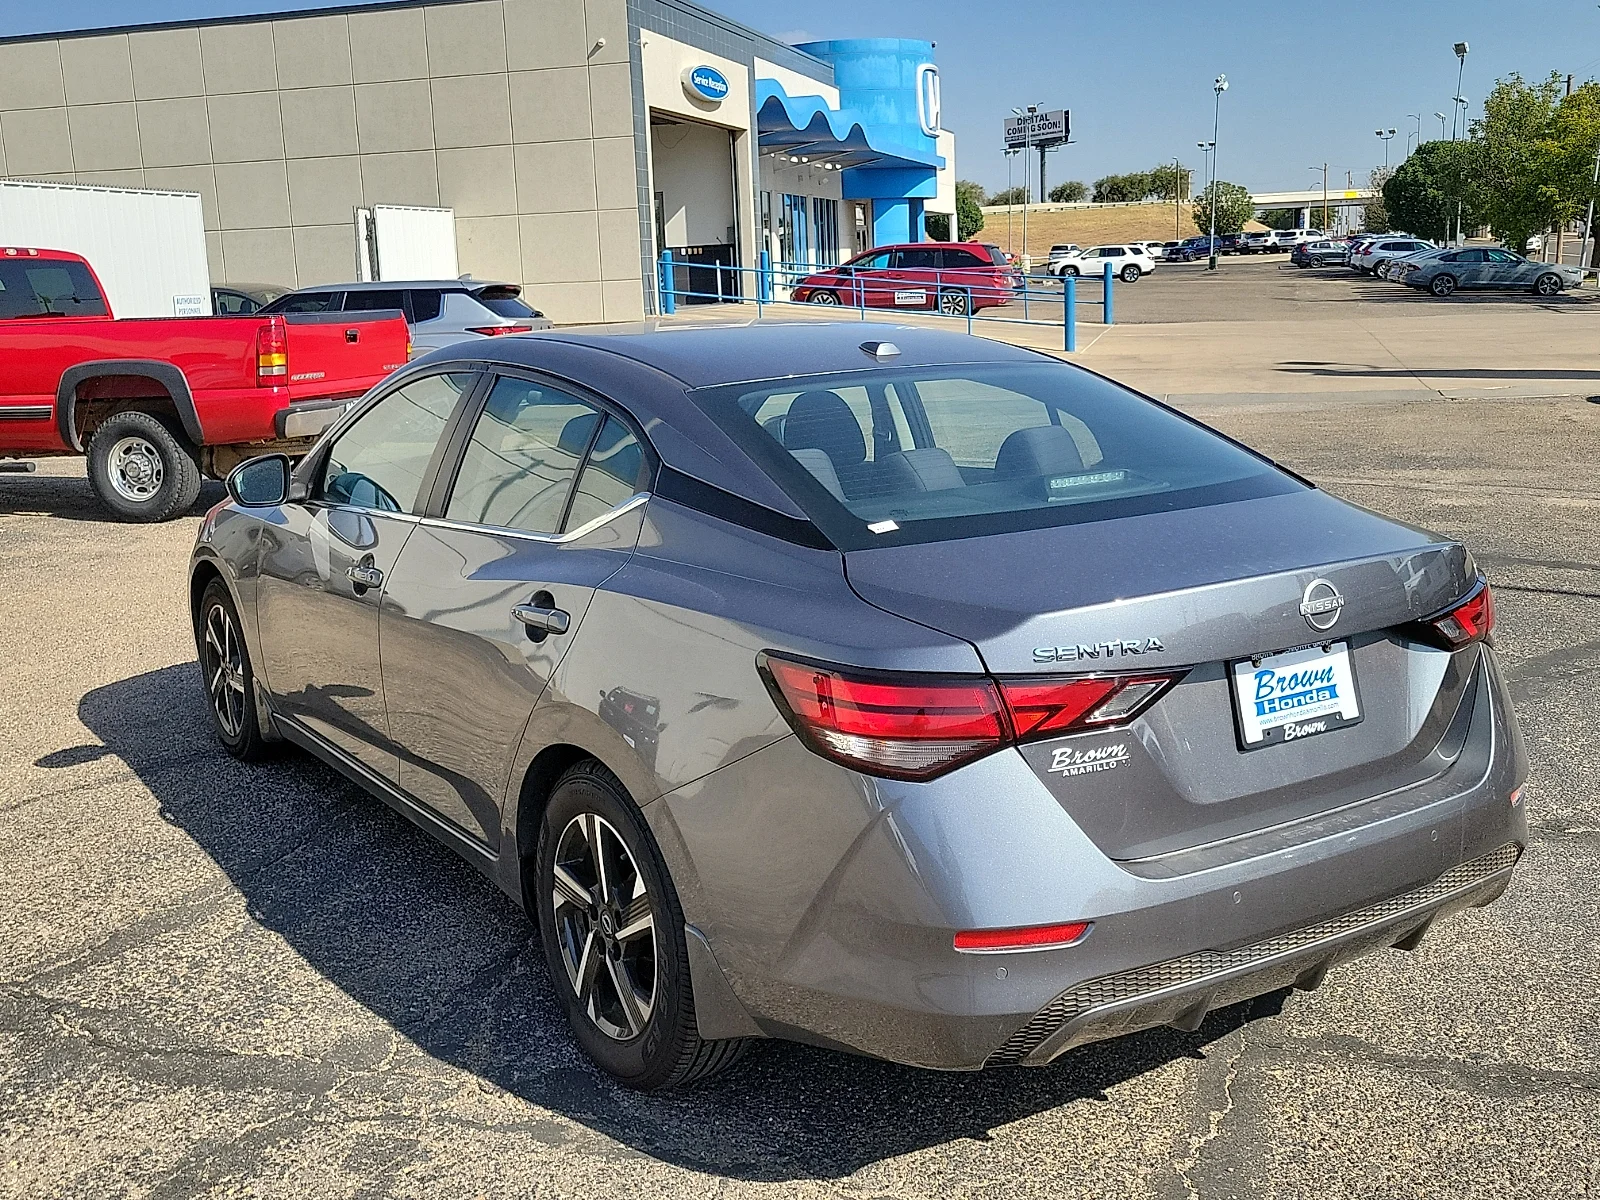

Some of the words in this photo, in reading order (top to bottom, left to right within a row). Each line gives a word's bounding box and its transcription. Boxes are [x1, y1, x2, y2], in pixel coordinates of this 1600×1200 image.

[1007, 125, 1036, 136] COMIG
[1037, 121, 1061, 131] SOON!
[1300, 595, 1345, 615] NISSAN
[1033, 637, 1165, 663] SENTRA
[1254, 666, 1334, 700] Brown
[1263, 688, 1331, 714] Honda
[1283, 721, 1327, 741] Brown
[1051, 744, 1128, 769] Brown
[1062, 761, 1117, 777] AMARILLO
